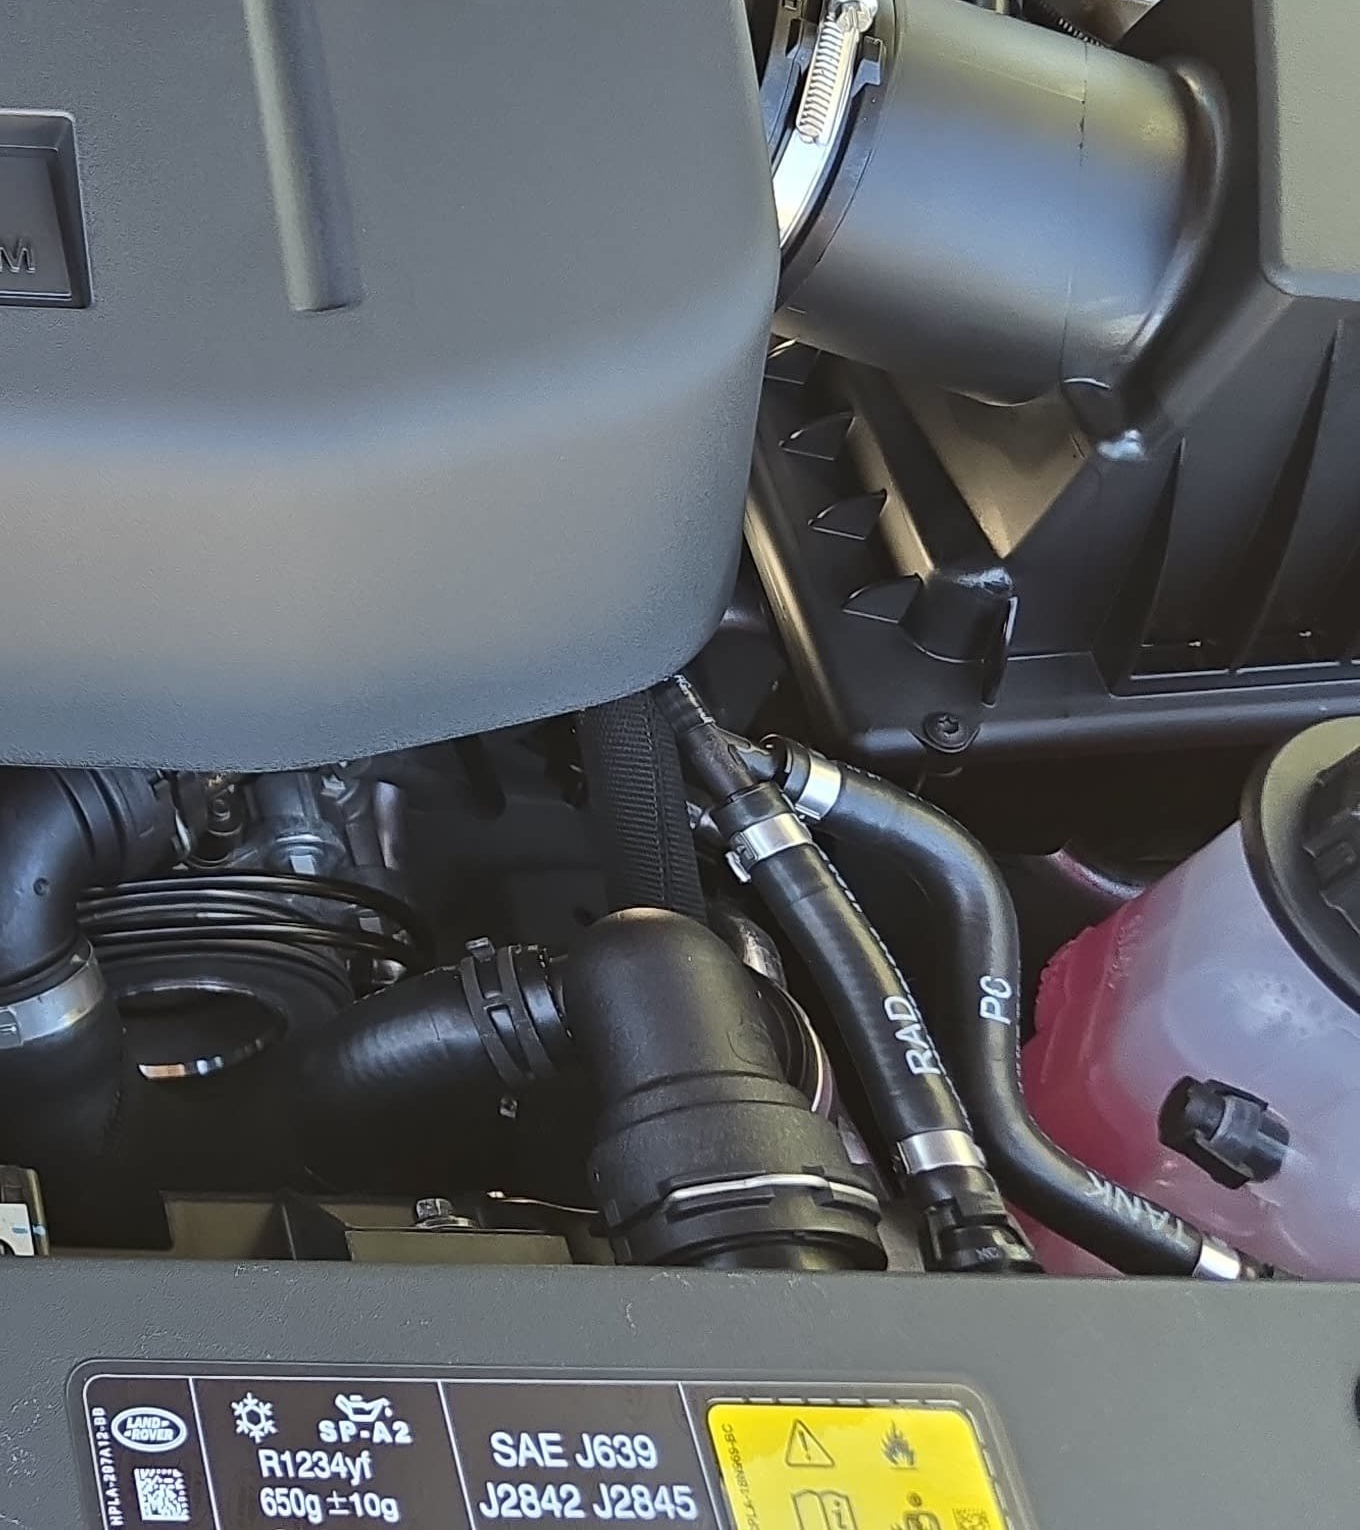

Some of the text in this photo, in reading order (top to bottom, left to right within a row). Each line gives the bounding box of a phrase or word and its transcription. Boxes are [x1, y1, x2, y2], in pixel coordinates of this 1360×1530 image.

[883, 994, 942, 1076] RAD
[1083, 1169, 1189, 1251] TANK
[126, 1415, 161, 1429] LAND
[130, 1428, 174, 1441] ROVER
[318, 1420, 414, 1445] SP-A2
[257, 1448, 373, 1486] R1234yf
[490, 1430, 659, 1470] SAE J639
[260, 1487, 400, 1523] 650g ±10g
[478, 1481, 699, 1520] J2842 J2845
